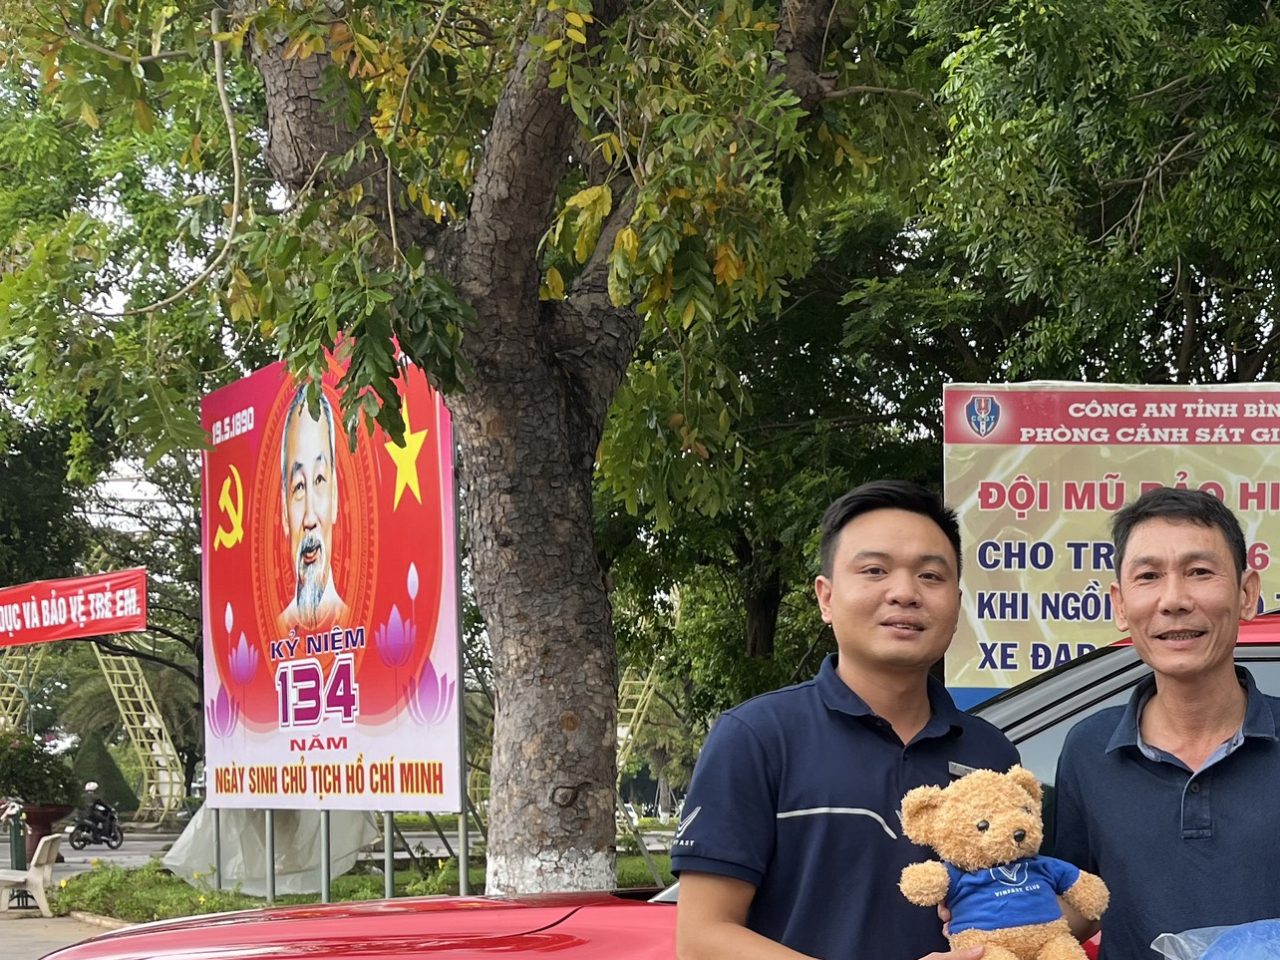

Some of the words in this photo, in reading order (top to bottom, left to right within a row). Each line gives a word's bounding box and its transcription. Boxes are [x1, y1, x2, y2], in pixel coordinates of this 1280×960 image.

[1068, 400, 1137, 418] CÔNG
[1142, 403, 1176, 418] AN
[1183, 399, 1238, 418] TỈNH
[1020, 424, 1109, 442] PHÒNG
[1116, 424, 1188, 442] CẢNH
[1195, 424, 1244, 442] SÁT
[978, 475, 1049, 519] ĐỘI
[1064, 473, 1125, 511] MŨ
[978, 541, 1054, 570] CHO
[1067, 542, 1115, 570] TR
[22, 595, 40, 629] VÀ
[41, 589, 66, 627] BẢO
[69, 589, 87, 627] VỆ
[88, 582, 112, 620] TRẺ
[977, 592, 1029, 620] KHI
[1041, 580, 1112, 621] NGỒI
[271, 631, 299, 659] KỶ
[307, 626, 365, 656] NIỆM
[978, 643, 1018, 669] XE
[276, 655, 359, 729] 134
[290, 734, 348, 751] NĂM
[215, 762, 245, 794] NGÀY
[249, 766, 278, 795] SINH
[281, 758, 308, 795] CHỦ
[311, 762, 342, 800] TỊCH
[345, 753, 366, 794] HỒ
[369, 754, 396, 794] CHÍ
[400, 762, 444, 795] MINH
